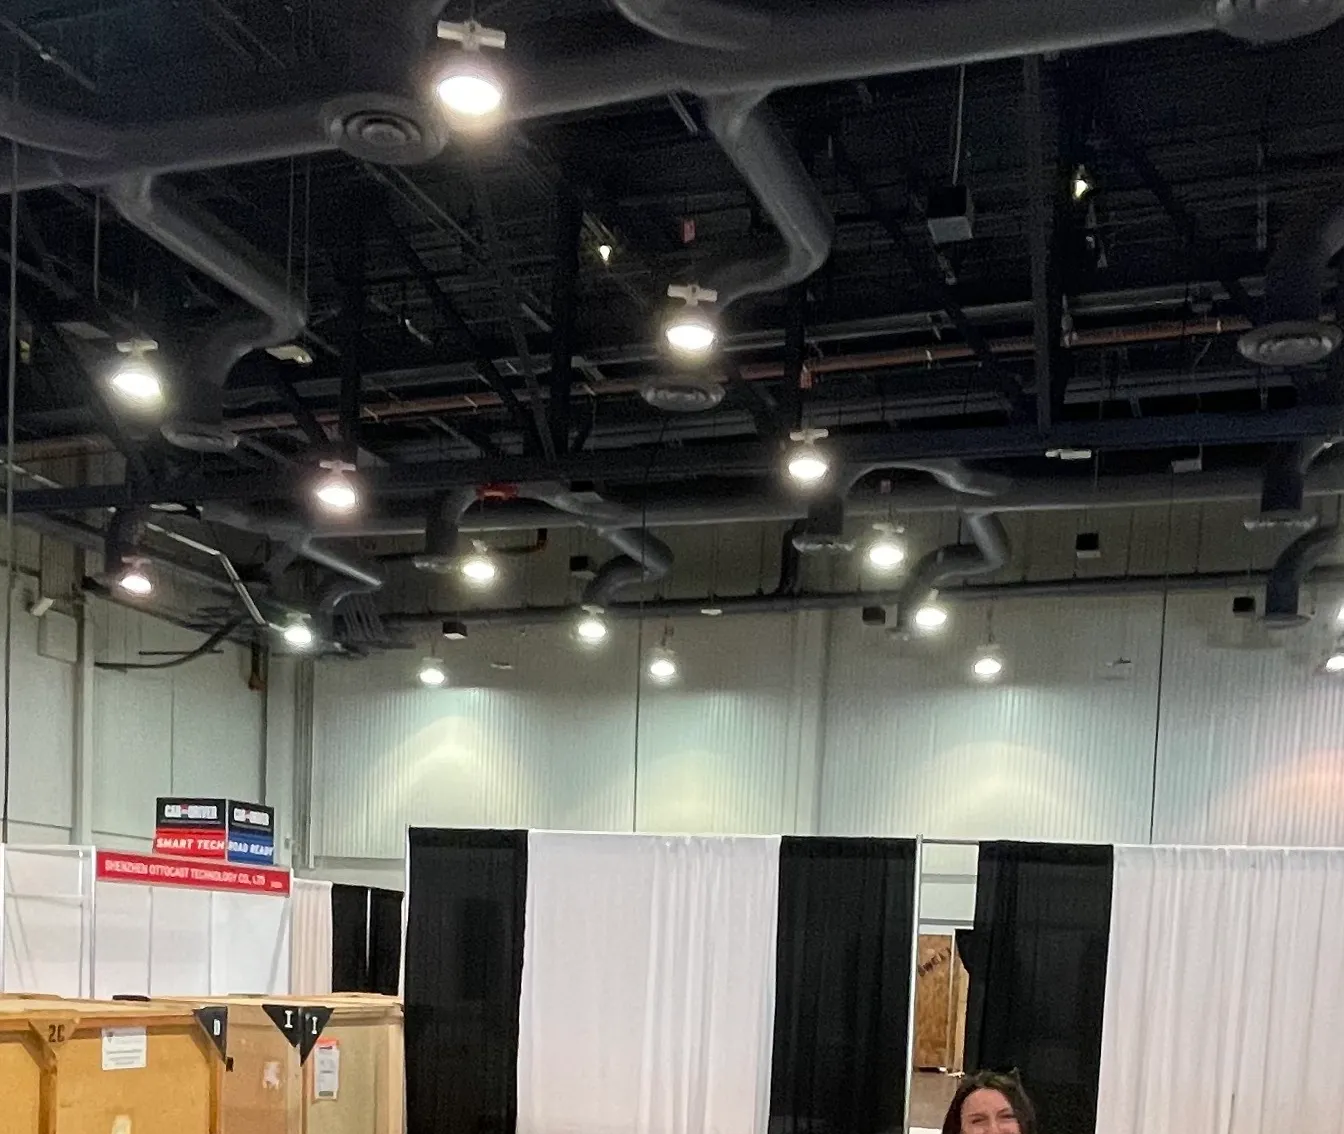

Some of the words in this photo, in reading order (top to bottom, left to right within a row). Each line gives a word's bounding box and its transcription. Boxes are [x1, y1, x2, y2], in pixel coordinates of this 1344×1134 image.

[156, 838, 194, 850] SMART
[197, 839, 225, 851] TECH
[250, 843, 274, 856] READY
[105, 859, 148, 874] SHENZHEN
[149, 864, 189, 878] OTTOCAST
[190, 868, 237, 882] TECHNOLOGY
